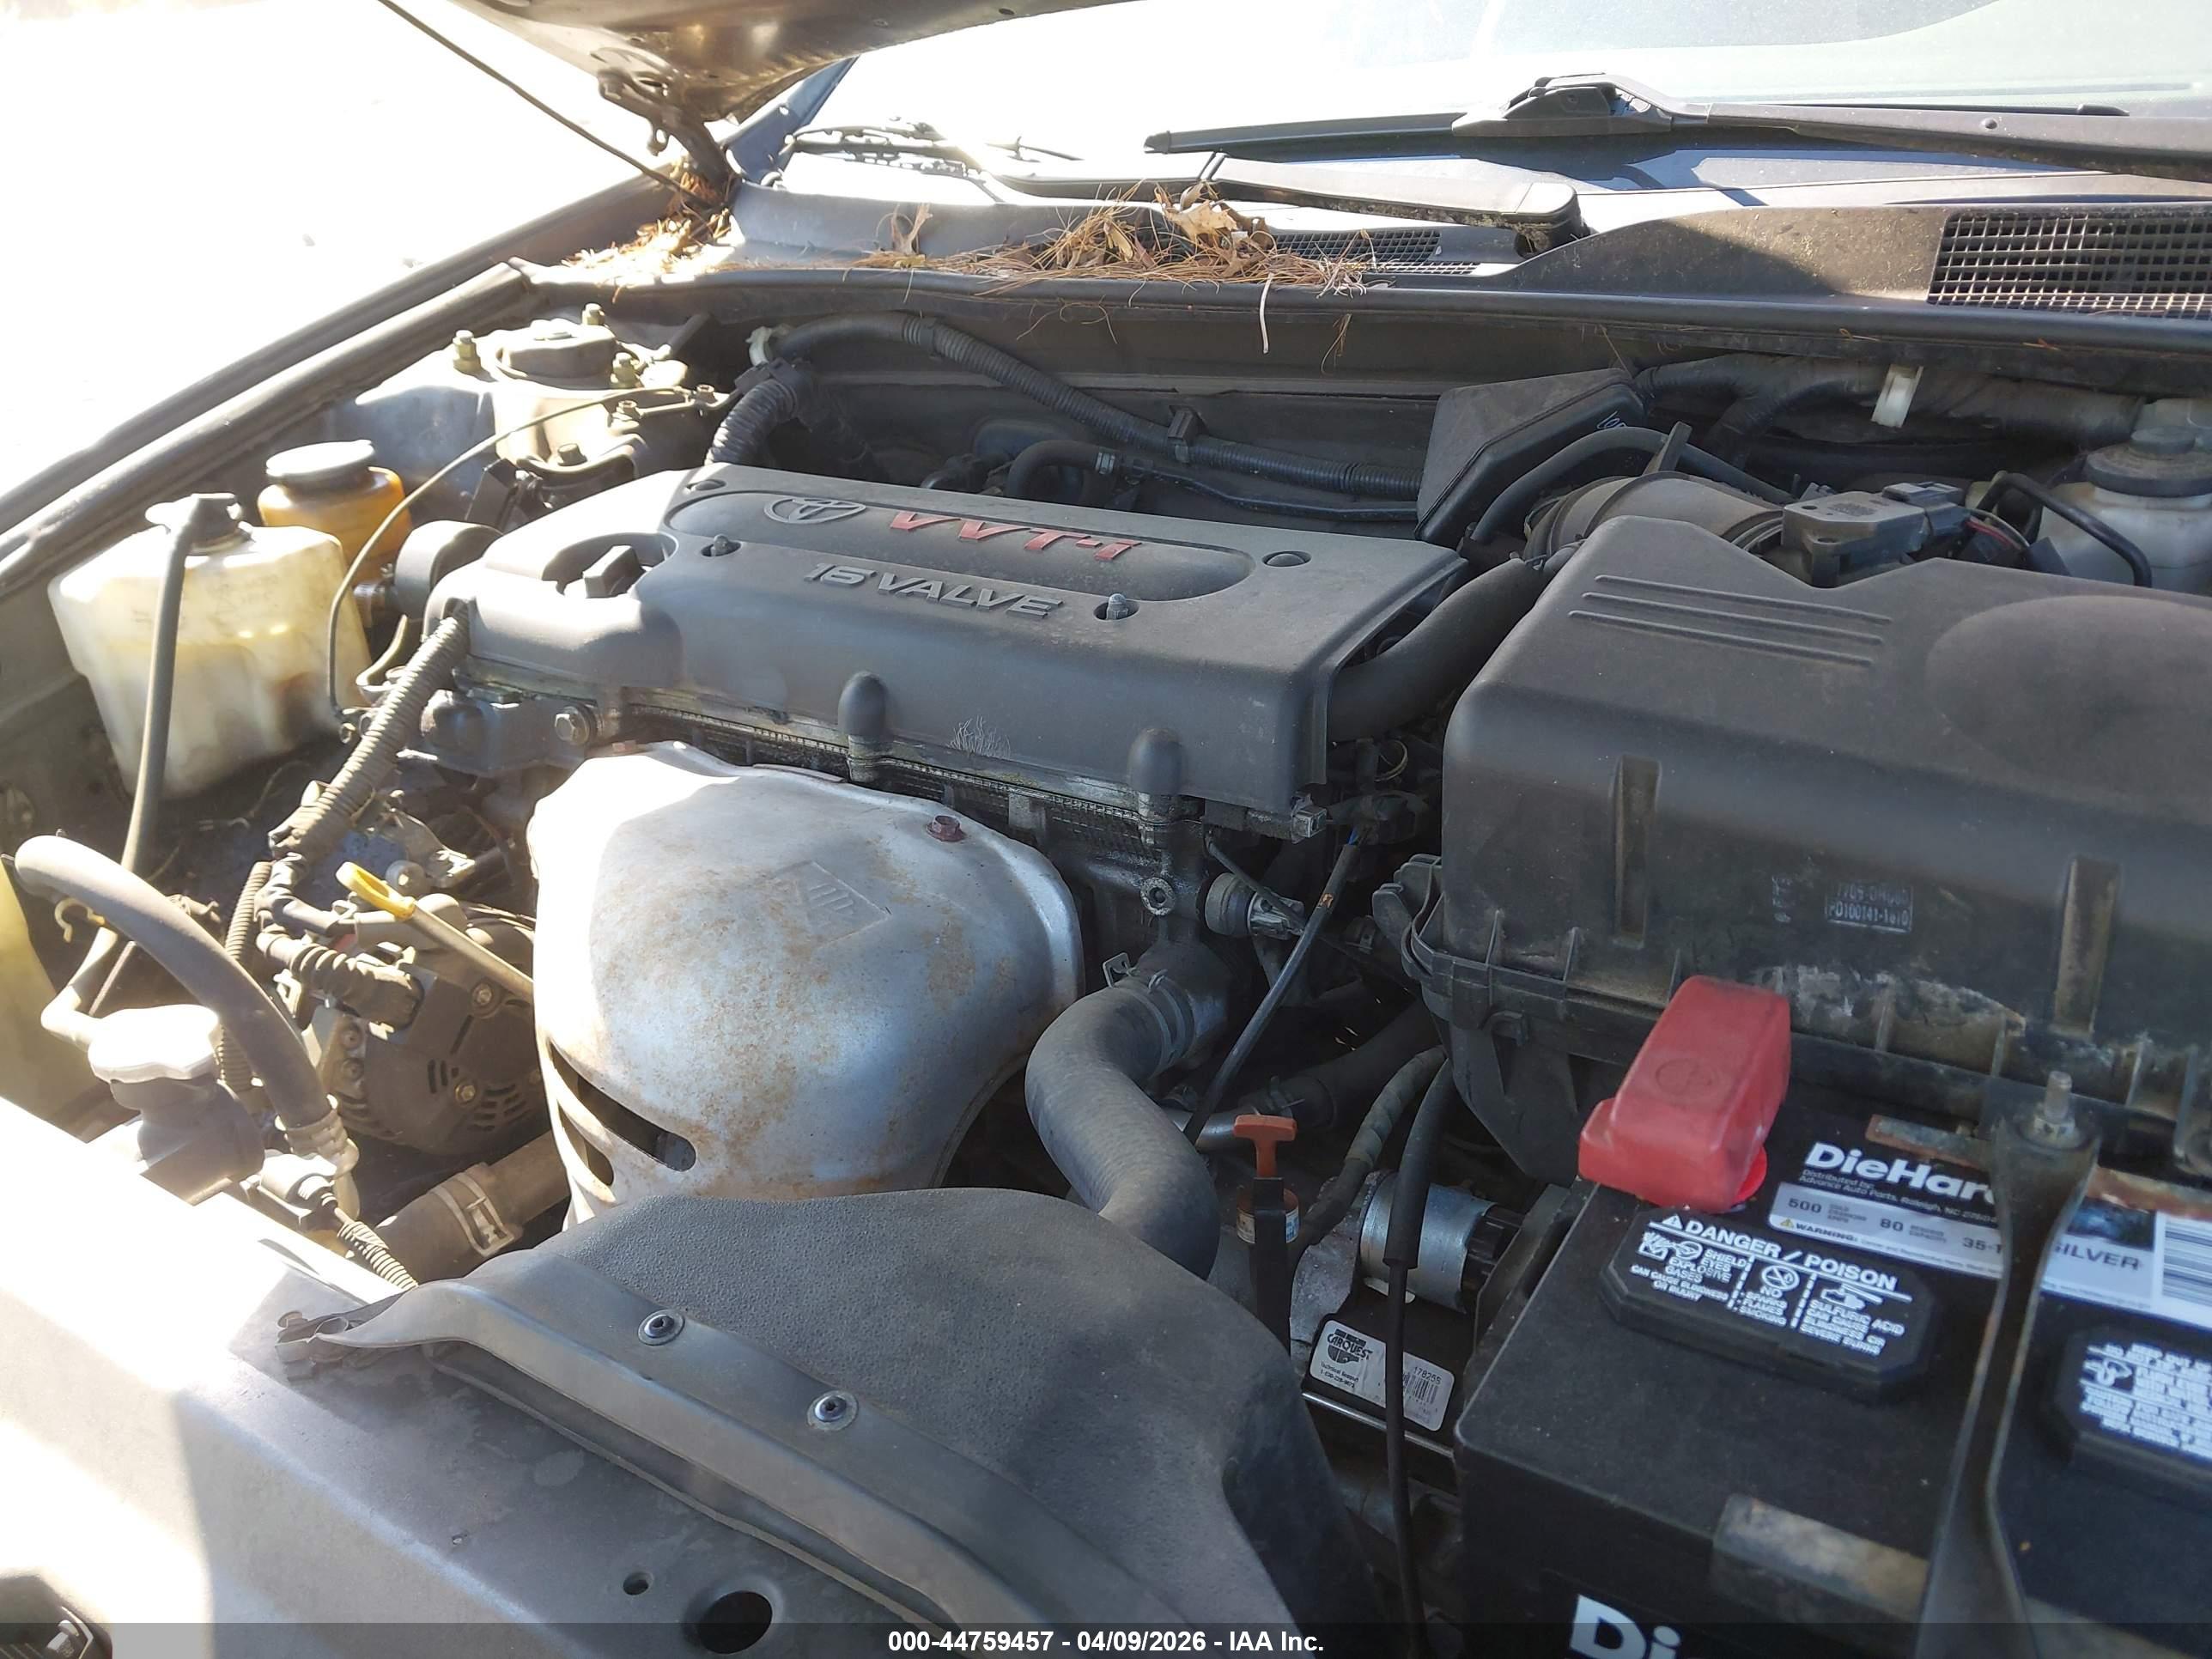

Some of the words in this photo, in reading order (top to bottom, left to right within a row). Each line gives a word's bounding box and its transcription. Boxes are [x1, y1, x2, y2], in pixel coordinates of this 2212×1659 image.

[889, 510, 1142, 561] VVT-i
[804, 563, 876, 586] 16
[878, 572, 1064, 619] VALVE
[1799, 1175, 1844, 1192] Advance
[1845, 1184, 1868, 1196] Auto
[1788, 1198, 1822, 1214] 500
[1880, 1218, 1904, 1233] 80
[1685, 1219, 1782, 1258] DANGER
[1784, 1250, 1802, 1262] /
[1804, 1254, 1898, 1291] POISON
[1701, 1257, 1731, 1272] EYES
[1704, 1249, 1747, 1268] SHIELD
[1665, 1266, 1704, 1283] GASES
[1669, 1256, 1732, 1284] EXPLOSIVE
[1745, 1291, 1788, 1310] SPARKS
[1760, 1285, 1783, 1298] NO
[1739, 1304, 1788, 1327] SMOKING
[1742, 1297, 1784, 1316] FLAMES
[1809, 1299, 1871, 1324] SULFURIC
[1871, 1318, 1905, 1337] ACID
[1327, 1334, 1374, 1361] CARQUEST
